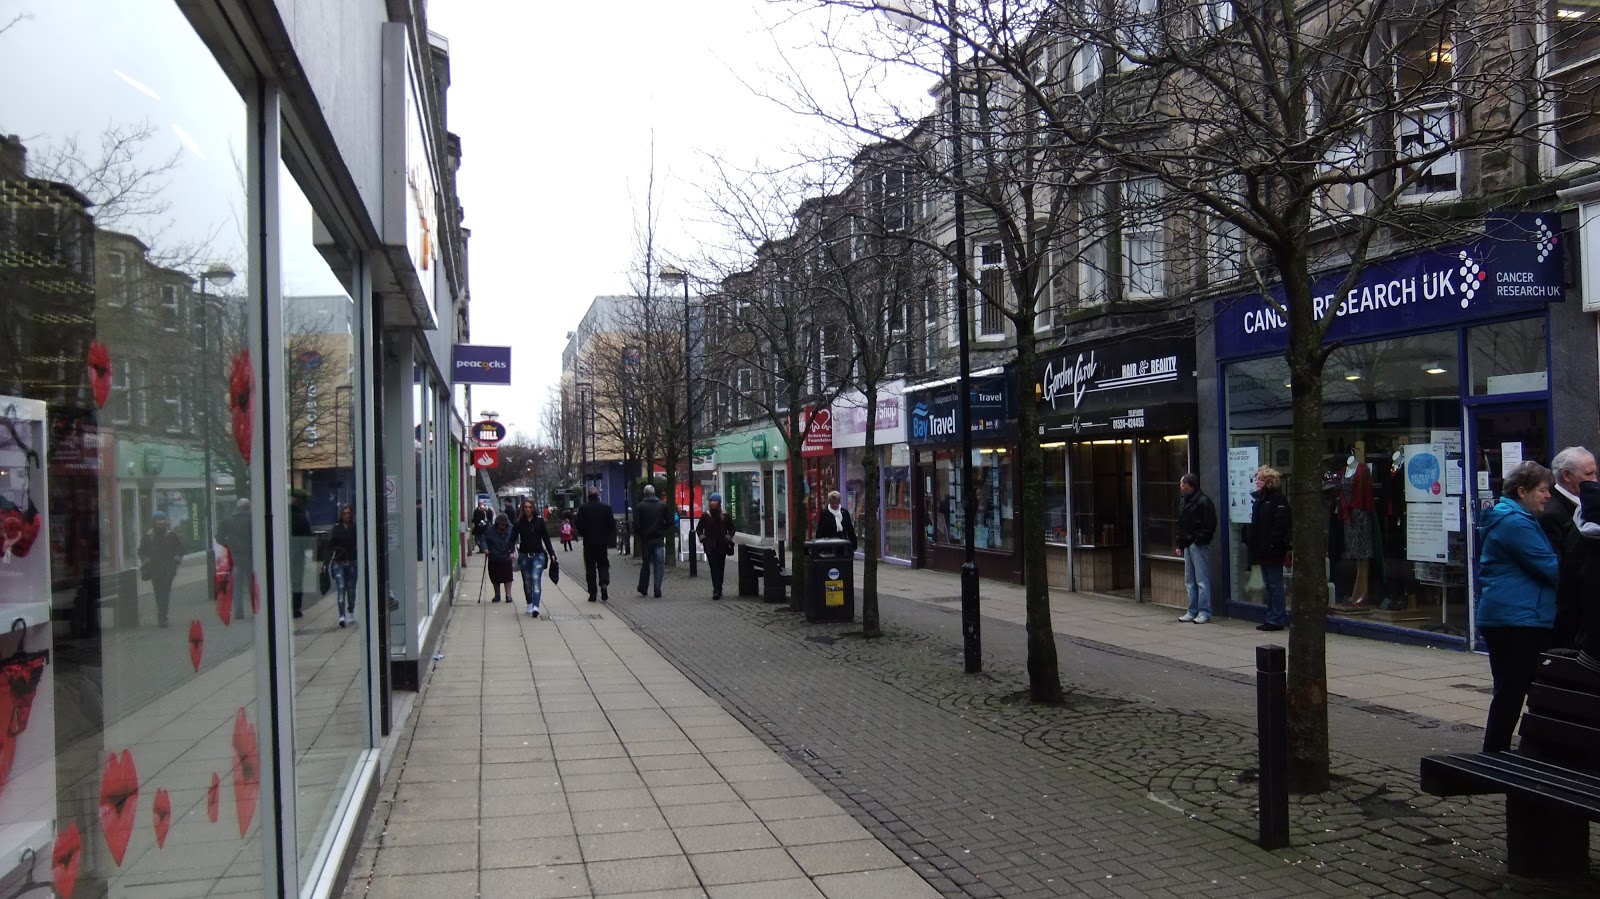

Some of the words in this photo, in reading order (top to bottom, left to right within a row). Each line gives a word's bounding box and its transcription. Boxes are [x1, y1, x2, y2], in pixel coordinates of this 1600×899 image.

[1496, 272, 1534, 283] CANCER
[1497, 285, 1545, 297] RESEARCH
[1547, 285, 1560, 297] UK
[1244, 304, 1288, 334] CANC
[1423, 268, 1456, 300] UK
[456, 360, 507, 370] peacocks
[1122, 363, 1137, 378] HAIR
[1139, 360, 1149, 375] &
[1151, 355, 1177, 374] BEAUTY
[979, 392, 1002, 402] Travel
[913, 418, 928, 442] Bay
[929, 409, 956, 435] Travel
[479, 430, 499, 440] HILL
